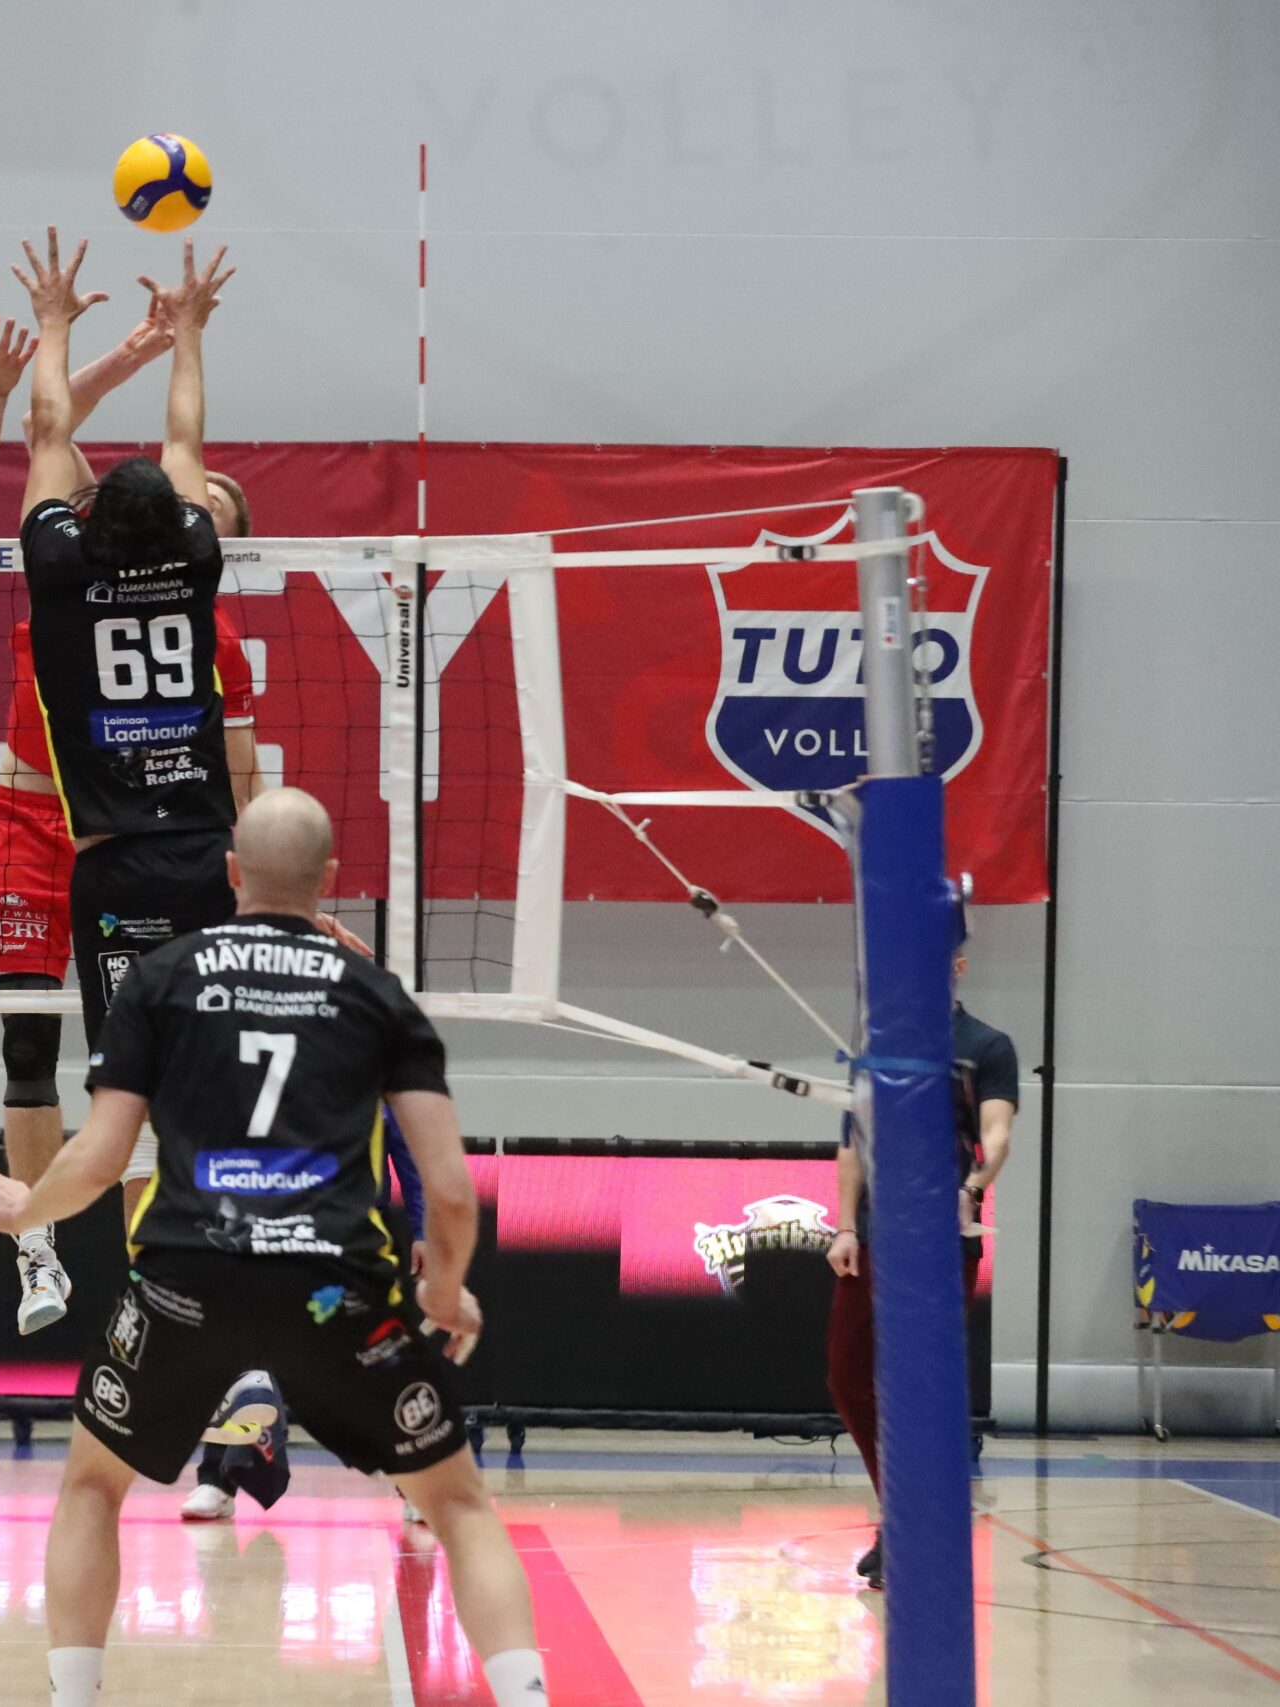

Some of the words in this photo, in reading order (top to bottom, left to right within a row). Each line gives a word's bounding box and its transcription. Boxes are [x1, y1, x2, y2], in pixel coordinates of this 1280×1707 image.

[412, 66, 1018, 168] VOLLEY
[396, 602, 411, 689] Universal
[94, 613, 195, 700] 69
[104, 716, 149, 725] Loimaan
[104, 724, 198, 742] Laatuauto
[144, 759, 174, 771] Ase
[146, 768, 209, 785] Retkeily
[107, 957, 130, 970] HO
[194, 938, 346, 983] HÄYRINEN
[234, 986, 327, 1004] OJARANNAN
[234, 1000, 315, 1016] RAKENNUS
[239, 1030, 296, 1138] 7
[95, 1374, 123, 1409] BE
